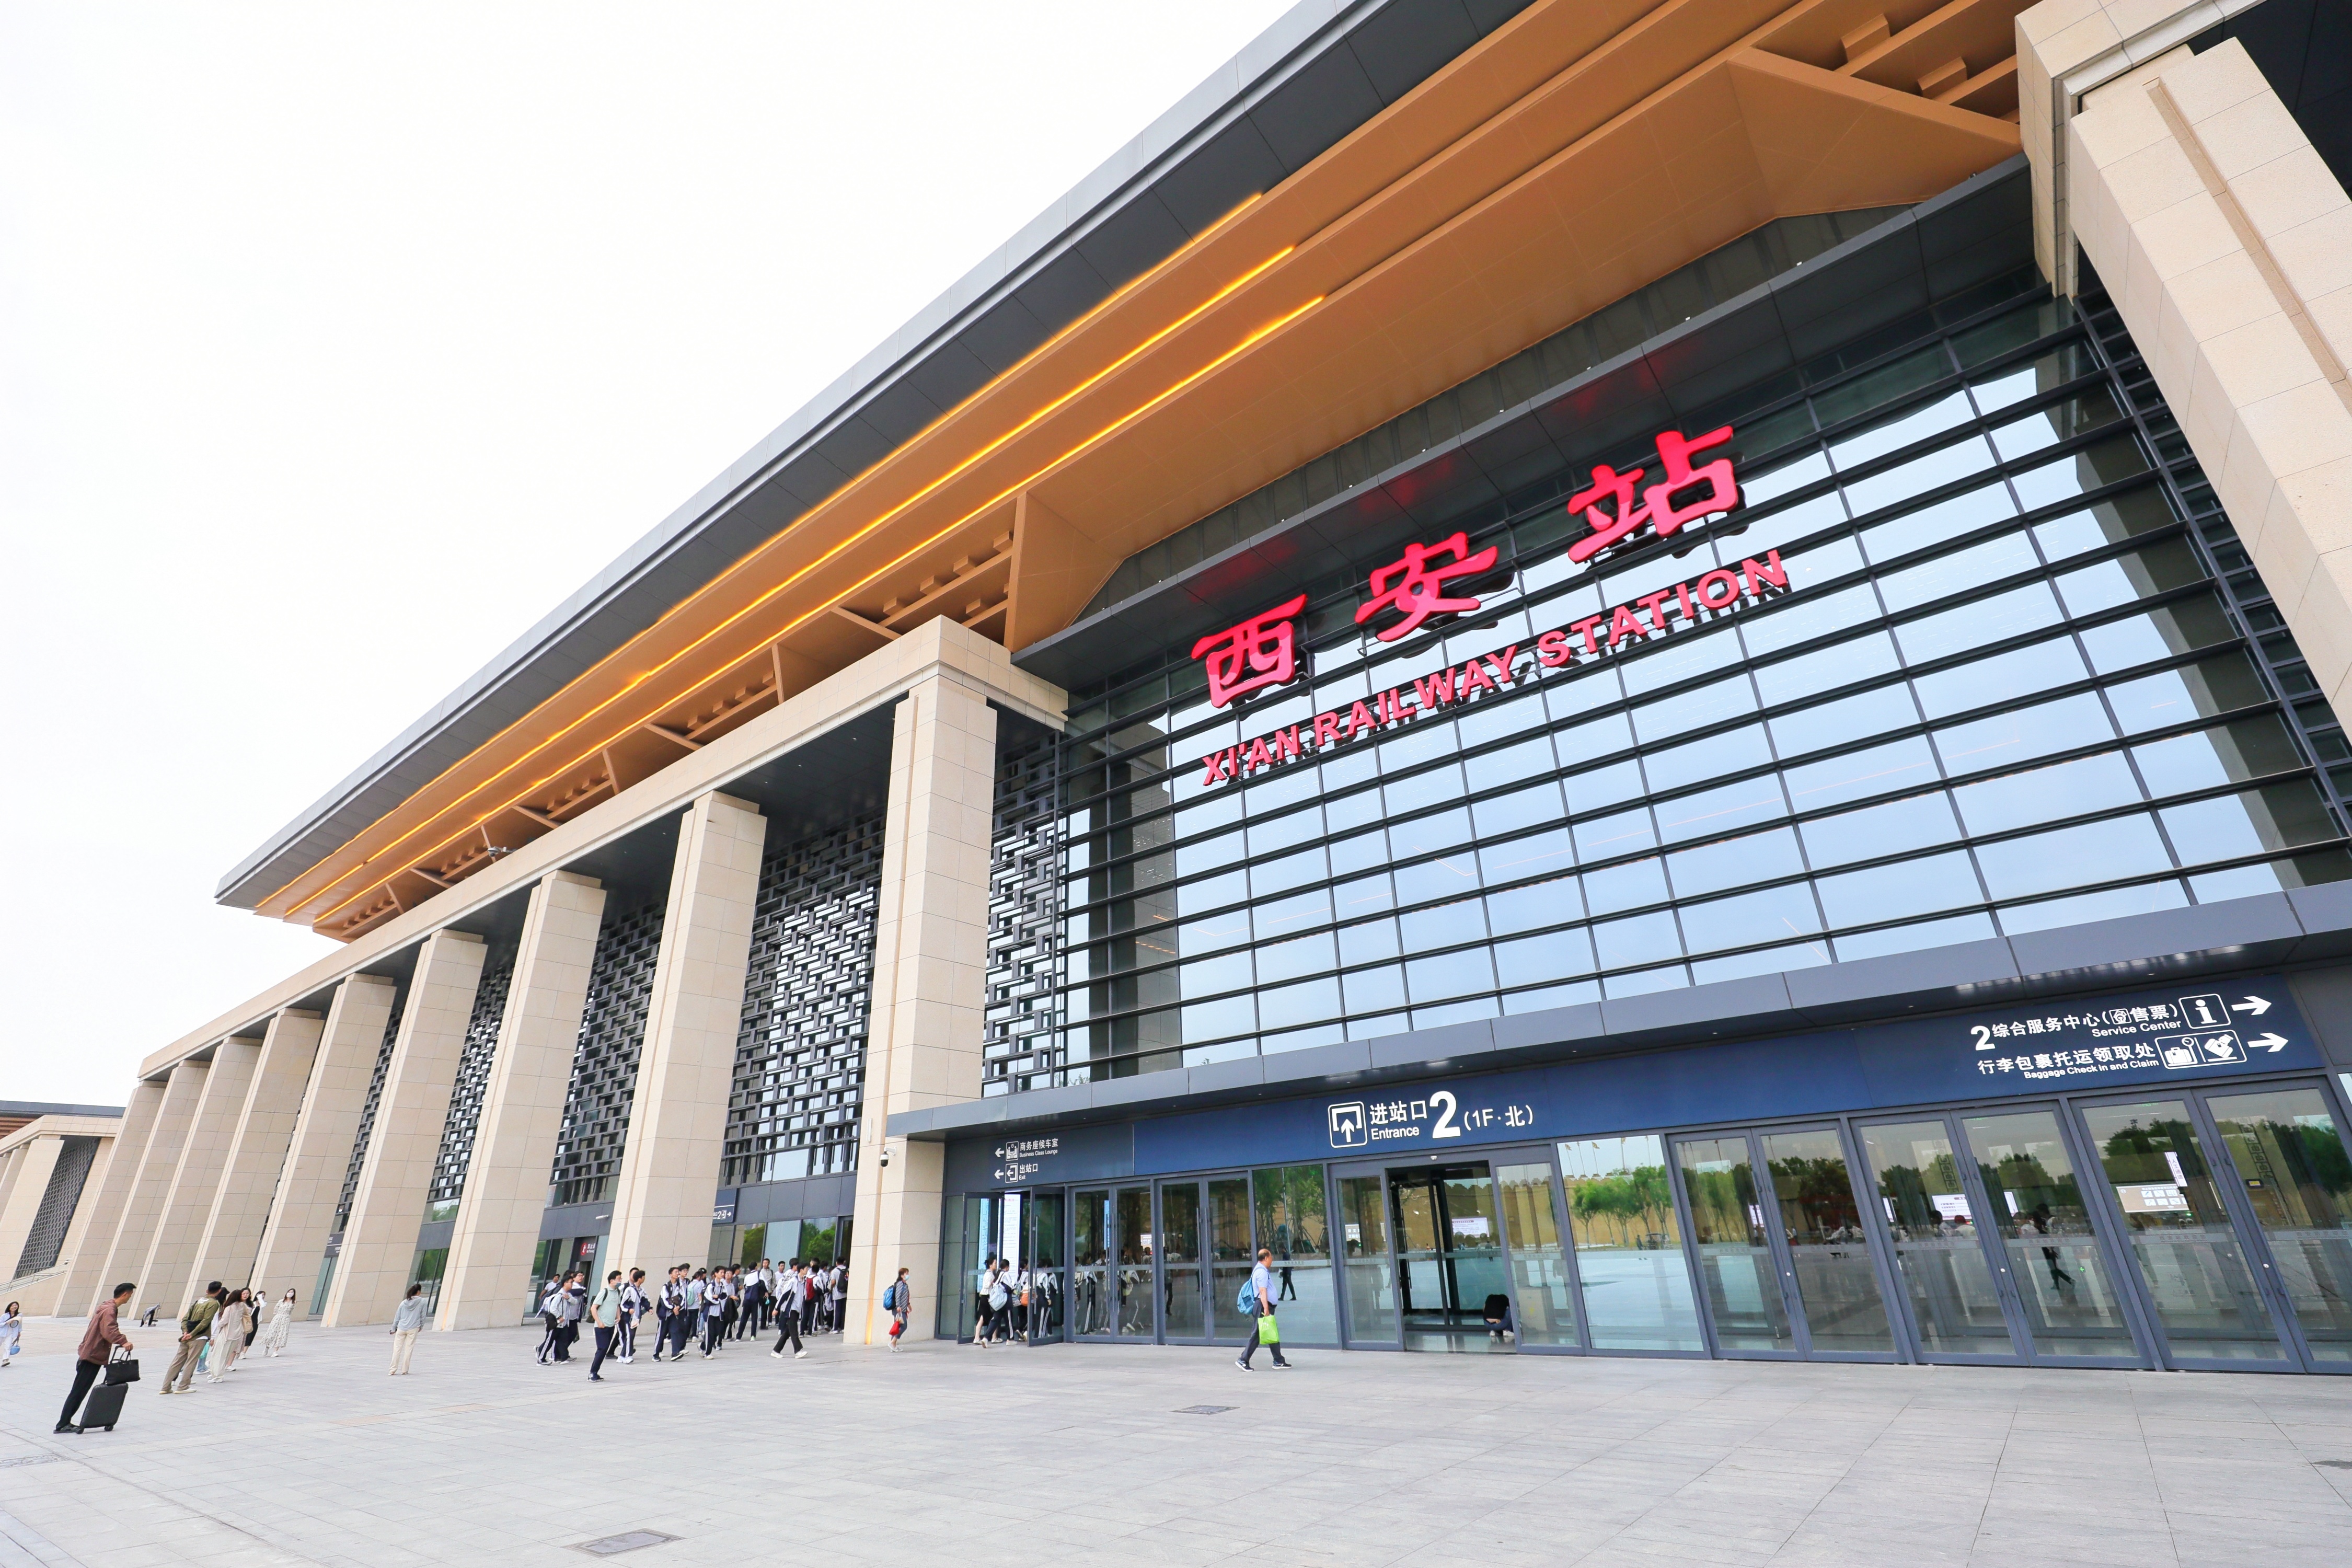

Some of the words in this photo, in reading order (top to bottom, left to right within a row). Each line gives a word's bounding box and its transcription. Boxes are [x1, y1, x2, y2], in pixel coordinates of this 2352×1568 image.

[1191, 425, 1739, 708] 西安站
[1202, 724, 1302, 786] XI'AN
[1313, 645, 1518, 747] RAILWAY
[1538, 550, 1789, 667] STATION
[1970, 1025, 1996, 1051] 2
[2091, 1026, 2137, 1037] Service
[2140, 1021, 2182, 1032] Center
[1977, 1042, 2157, 1075] 行李包裹托运领取处
[2024, 1069, 2066, 1079] Baggage
[2067, 1064, 2097, 1075] Check
[2109, 1061, 2129, 1070] and
[2129, 1059, 2160, 1069] Claim
[1369, 1100, 1427, 1125] 进站口
[1429, 1091, 1461, 1139] 2
[1371, 1126, 1420, 1140] Entrance
[1020, 1138, 1058, 1151] 商务座候车室
[1019, 1163, 1038, 1174] 出站口
[717, 1211, 721, 1219] 2
